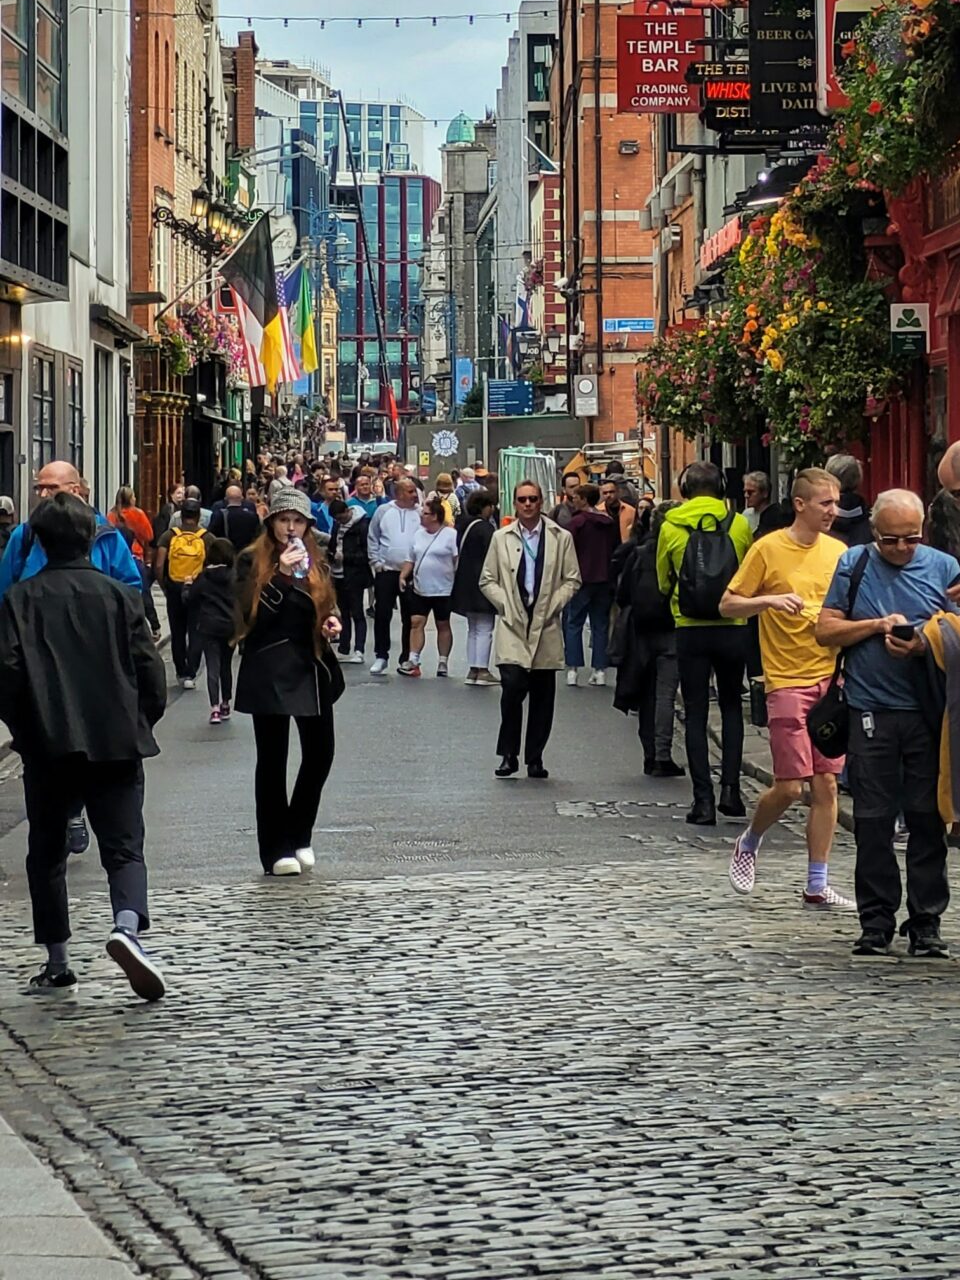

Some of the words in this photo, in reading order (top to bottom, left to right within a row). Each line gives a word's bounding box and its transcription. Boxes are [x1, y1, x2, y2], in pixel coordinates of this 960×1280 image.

[644, 22, 678, 36] THE
[756, 30, 792, 40] BEER
[626, 40, 696, 54] TEMPLE
[642, 59, 679, 72] BAR
[695, 64, 723, 75] THE
[636, 84, 688, 94] TRADING
[761, 82, 796, 94] LIVE
[631, 96, 690, 107] COMPANY
